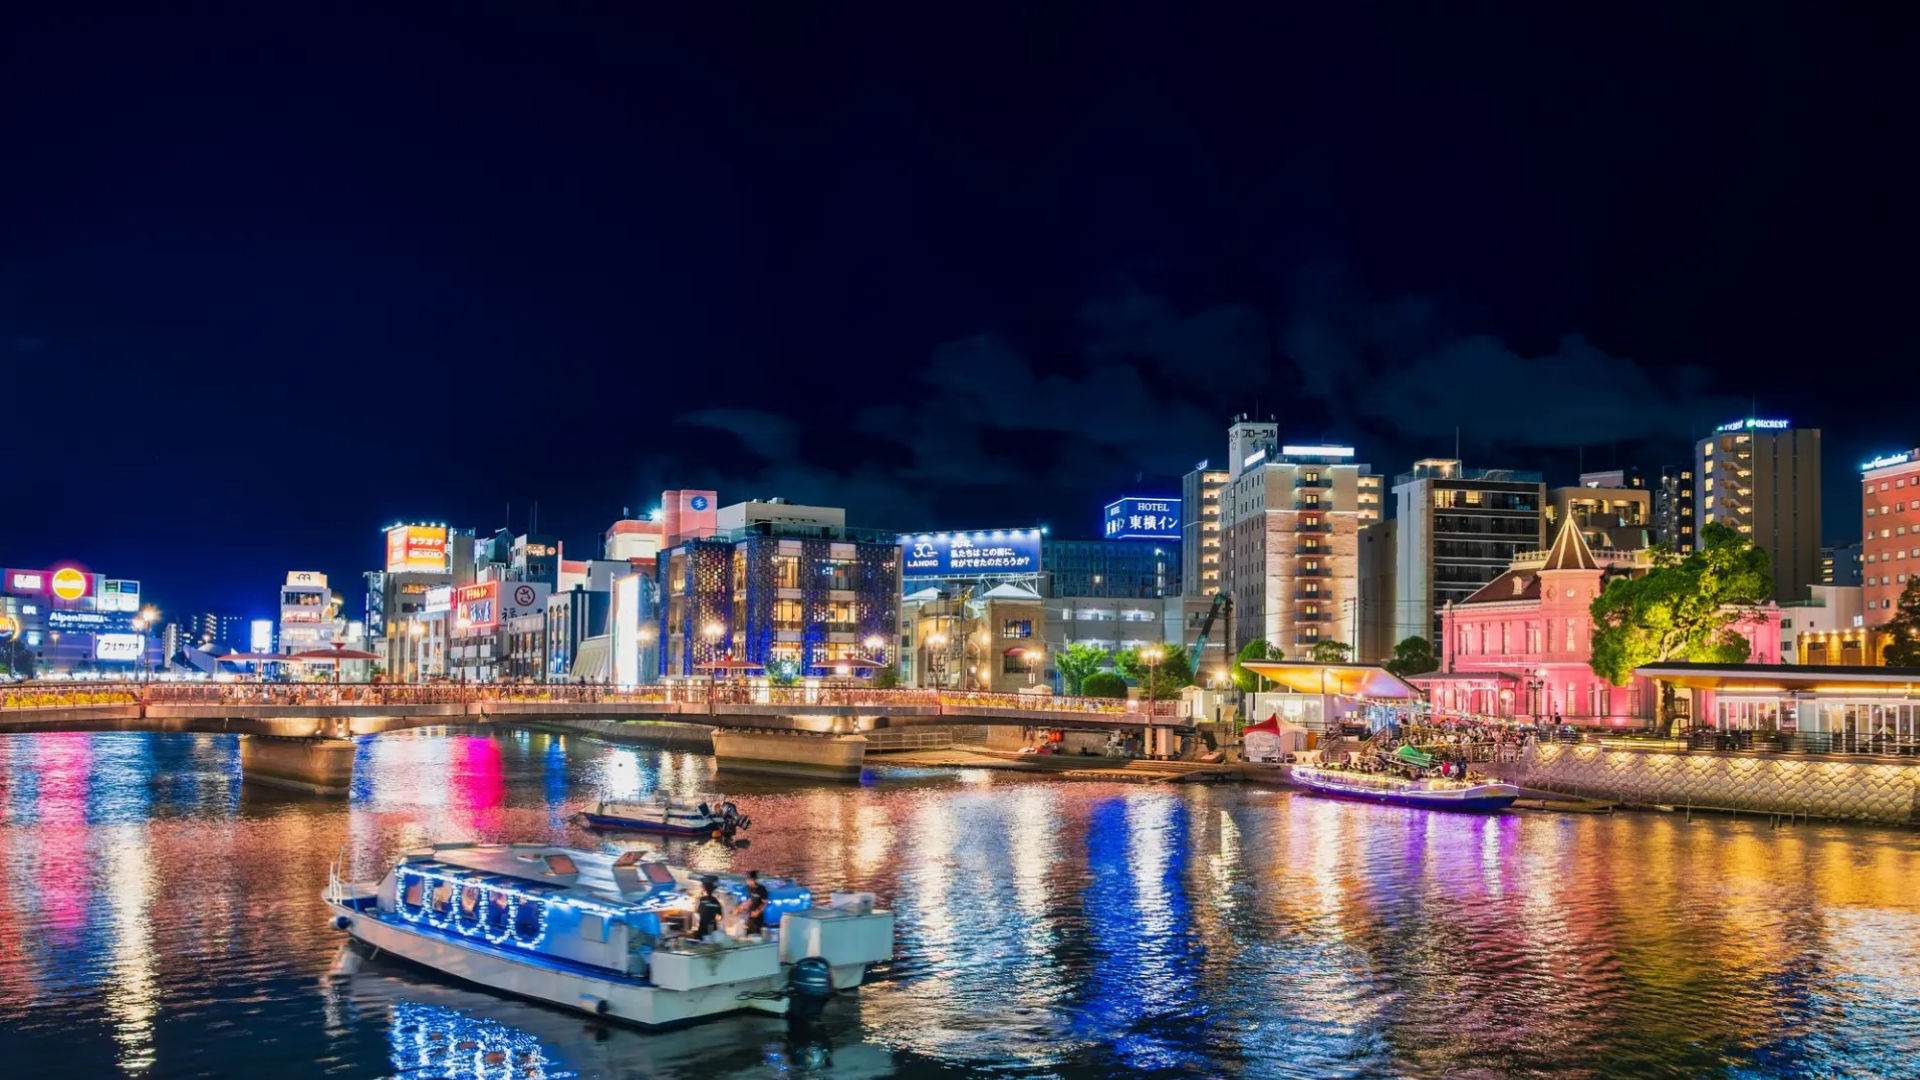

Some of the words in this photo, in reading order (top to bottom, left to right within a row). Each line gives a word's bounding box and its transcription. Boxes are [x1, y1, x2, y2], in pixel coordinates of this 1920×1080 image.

[1137, 502, 1170, 512] HOTEL
[1129, 514, 1179, 531] 東横イン
[409, 537, 443, 546] カラオケ
[907, 559, 939, 568] LANDIC
[49, 612, 79, 623] Alpen
